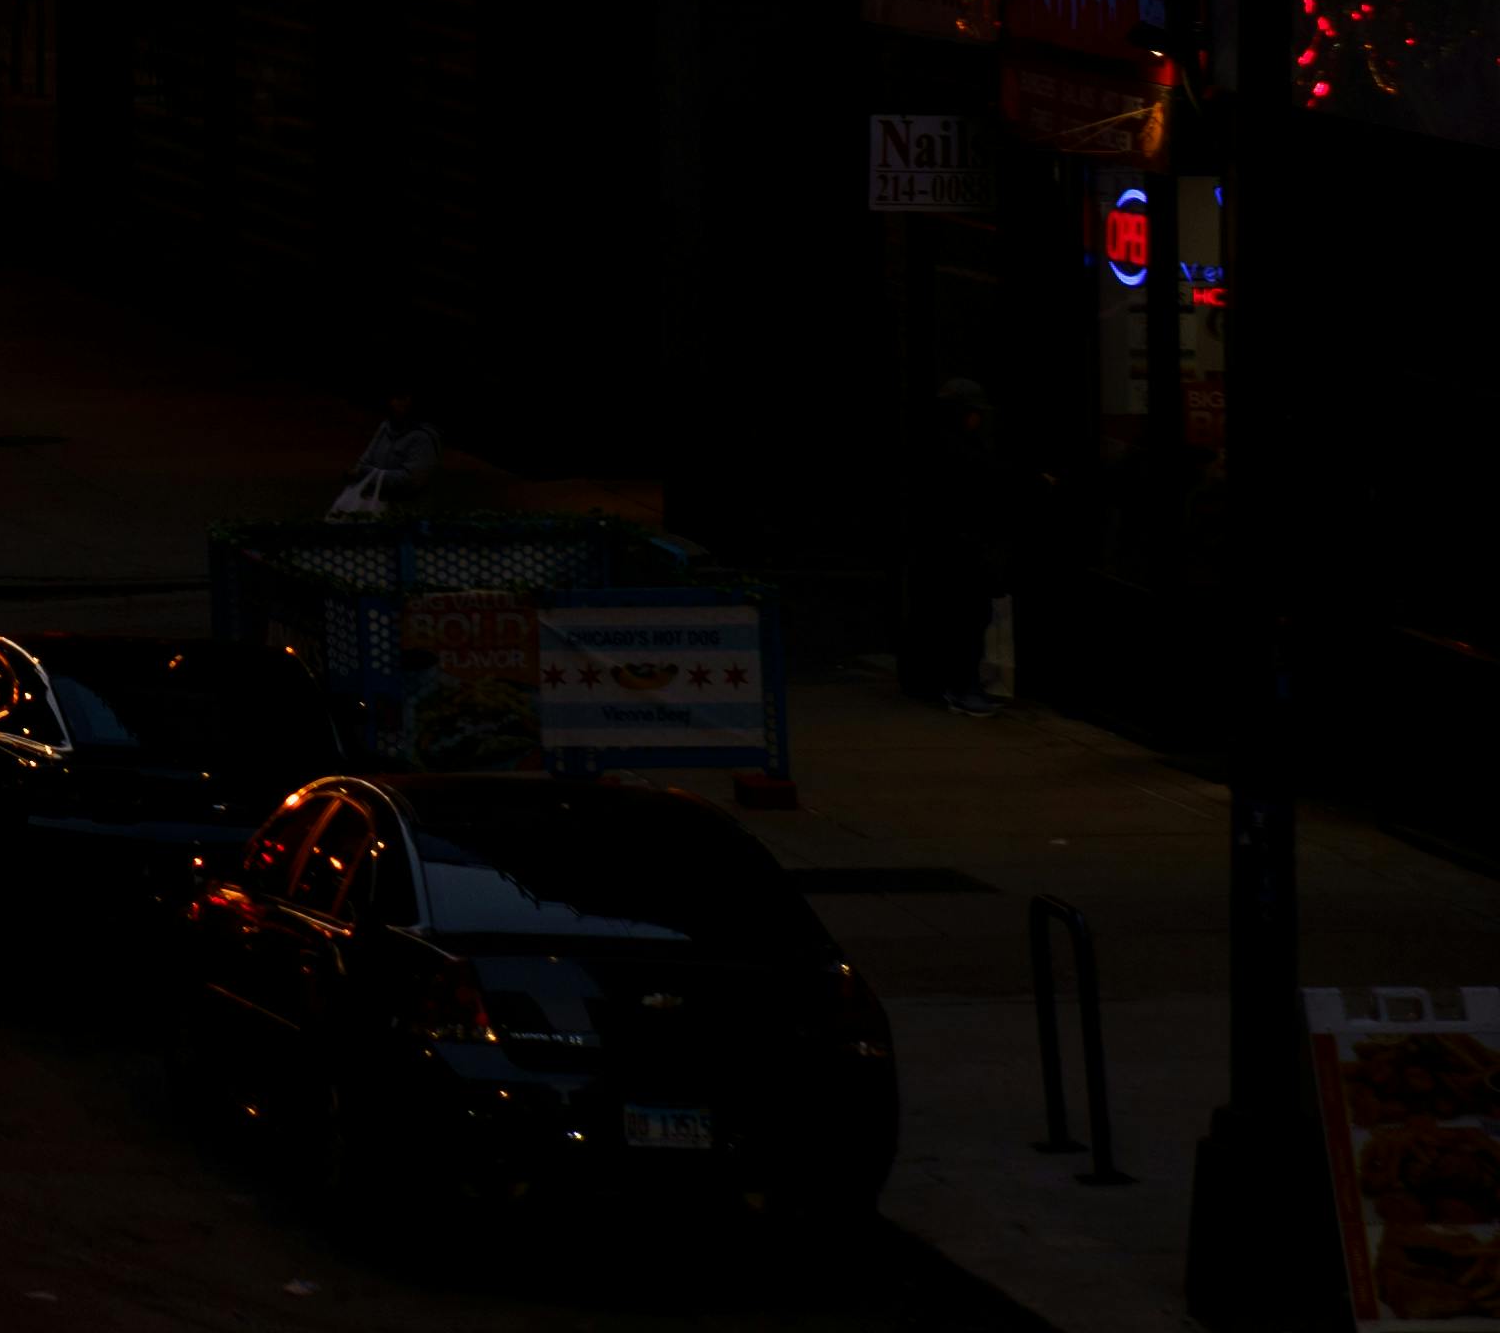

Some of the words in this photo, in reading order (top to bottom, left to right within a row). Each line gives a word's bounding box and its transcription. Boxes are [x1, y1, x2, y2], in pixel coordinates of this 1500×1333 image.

[408, 612, 531, 646] BOLD
[566, 629, 649, 646] CHICAGO'S
[652, 629, 683, 646] HOT
[687, 629, 723, 646] DOG
[438, 648, 528, 670] FLAVOR
[602, 705, 655, 723] Vienna
[656, 706, 692, 727] Beef
